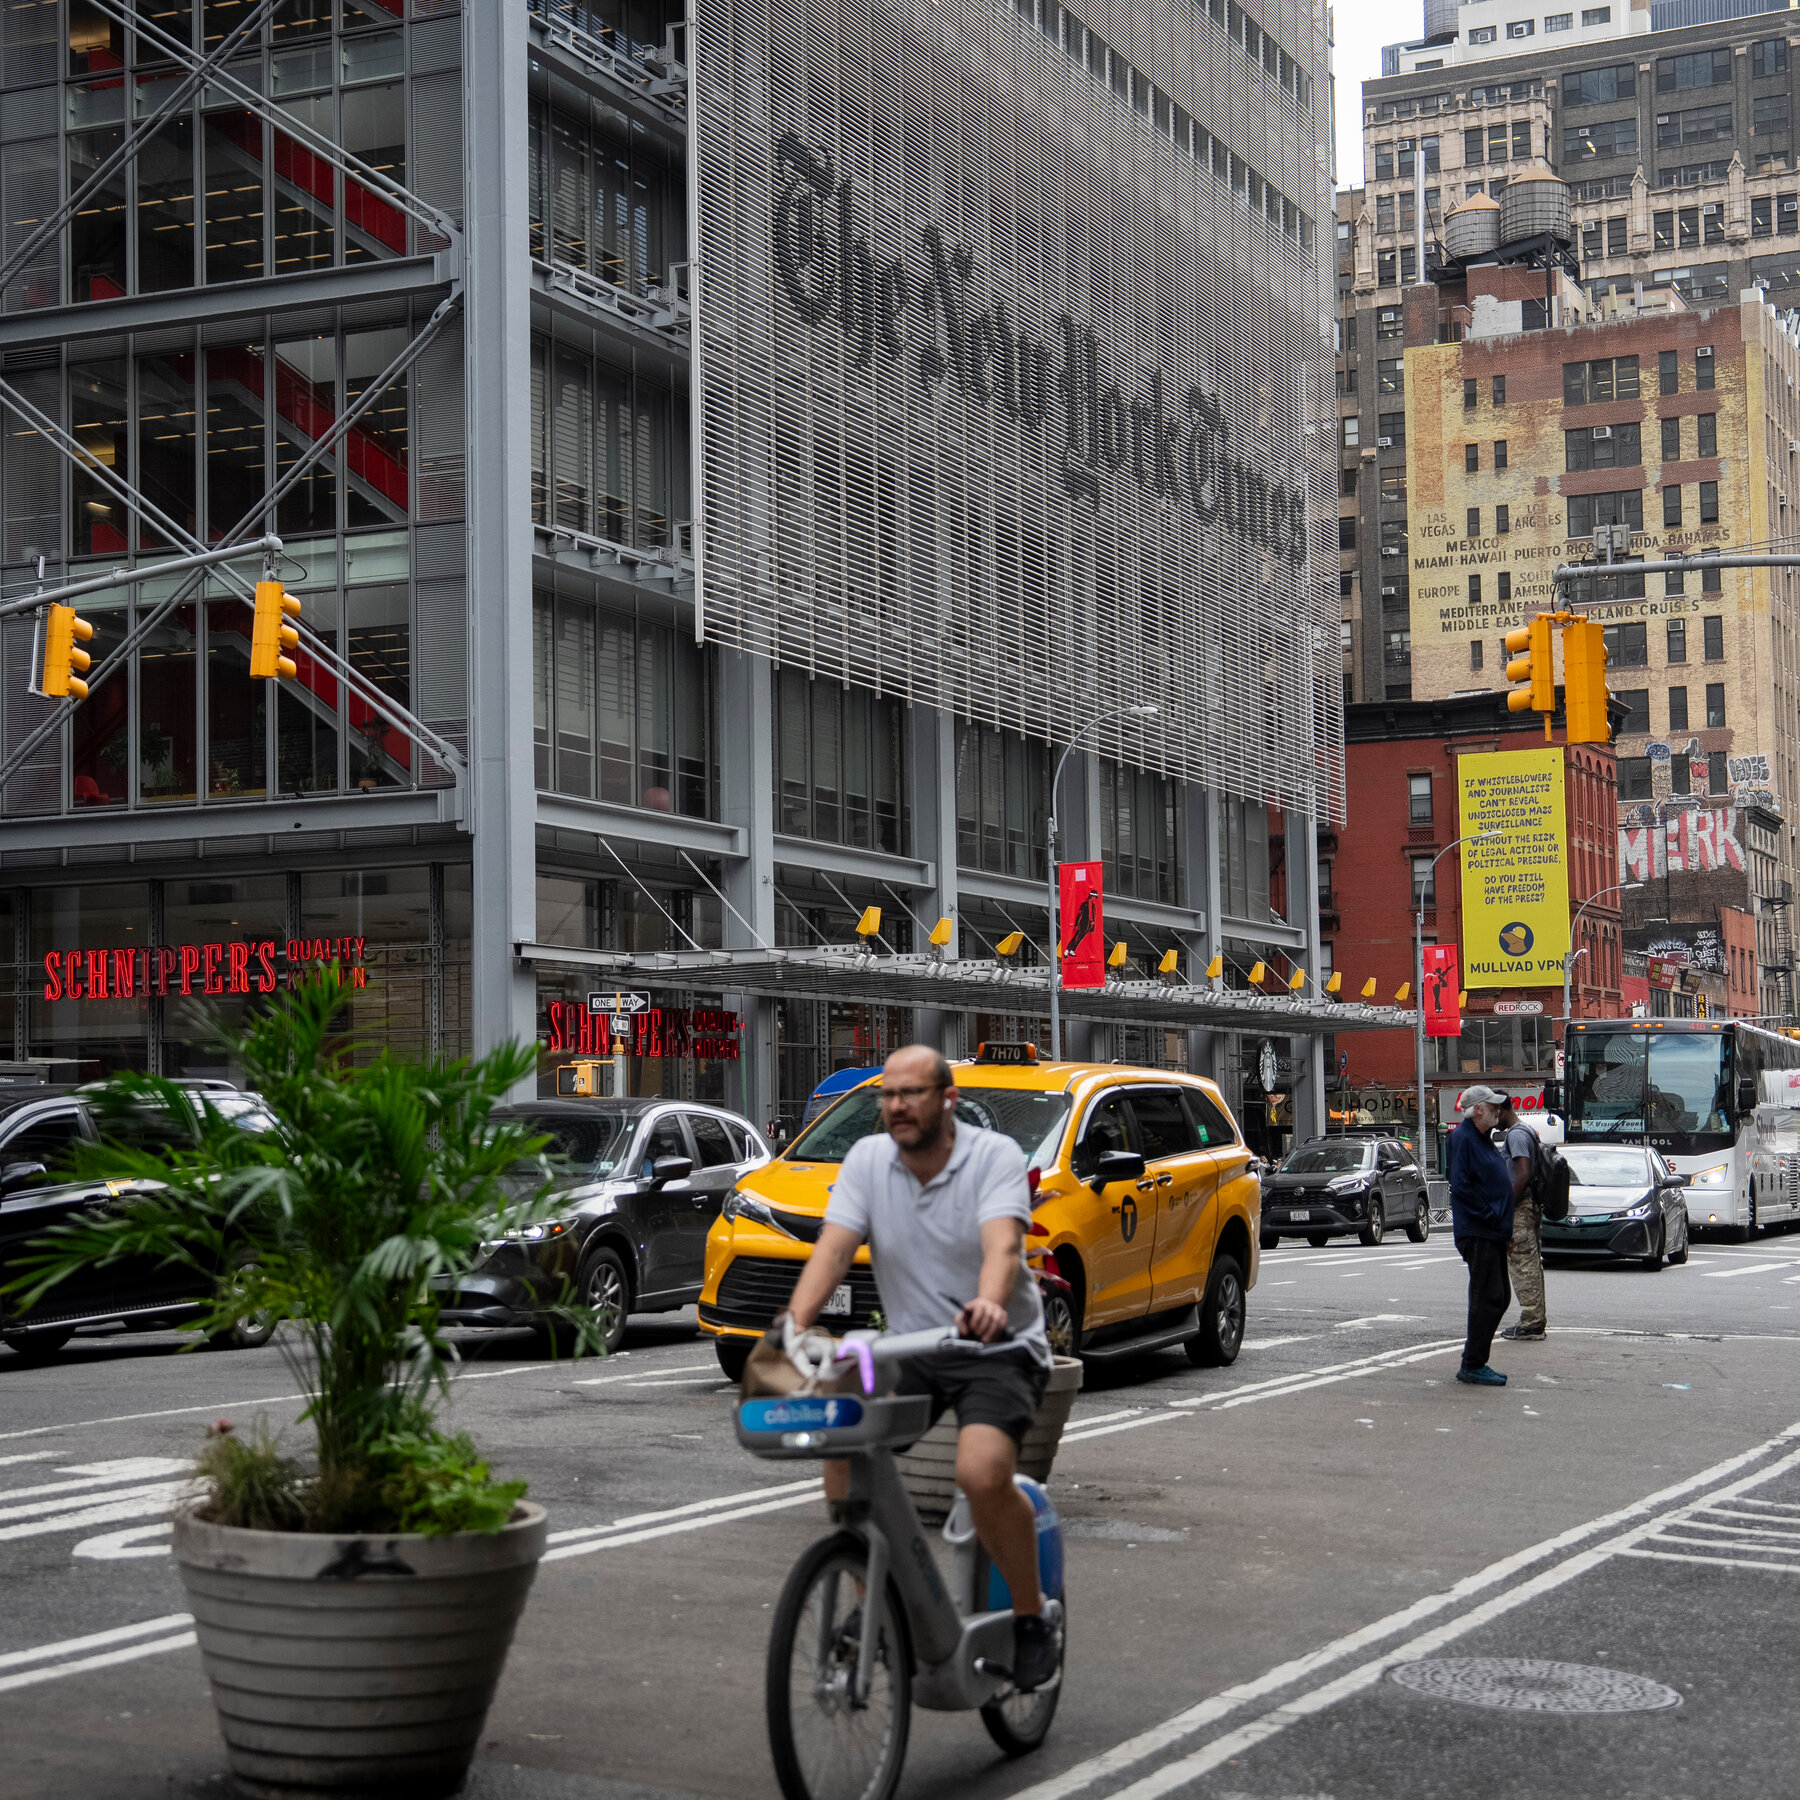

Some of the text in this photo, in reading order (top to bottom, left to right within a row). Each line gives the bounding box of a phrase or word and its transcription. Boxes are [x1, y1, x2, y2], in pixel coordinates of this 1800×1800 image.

[1427, 512, 1447, 524] LAS
[1515, 513, 1561, 529] ANGLES
[1420, 524, 1456, 538] VEGAS
[1446, 536, 1500, 553] MEXICO
[1414, 555, 1454, 570] MIAMI
[1460, 550, 1507, 566] HAWAII
[1514, 545, 1561, 561] PUERTO
[1566, 541, 1595, 556] RICO
[1418, 585, 1460, 599] EUROPE
[1440, 600, 1539, 620] MEDITERRANEA
[1441, 600, 1700, 633] MIDDLE EAS ISLAND CRUISES
[1465, 773, 1552, 788] IF WHISTLEBLOWERS
[1468, 784, 1550, 798] AND JOURNALISTS
[1480, 796, 1539, 808] CAN'T REVEAL
[1468, 805, 1552, 820] UNDISCLOSED MASS
[1478, 817, 1543, 830] SURVEILLANCE
[1471, 833, 1555, 846] WITHOUT THE RISK
[1468, 843, 1559, 858] OF LEGAL ACTION OR
[1468, 854, 1561, 869] POLITICAL PRESSURE,
[1485, 873, 1543, 884] DO YOU STILL
[1484, 883, 1545, 895] HAVE FREEDOM
[1485, 893, 1545, 905] OF THE PRESS?
[44, 942, 276, 1001] SCHNIPPER'S
[286, 936, 365, 961] QUALITY
[1470, 959, 1565, 974] MULLVAD VPN
[595, 999, 639, 1007] ONE WAY
[1697, 995, 1706, 1018] BAR
[991, 1046, 1021, 1060] 7H70
